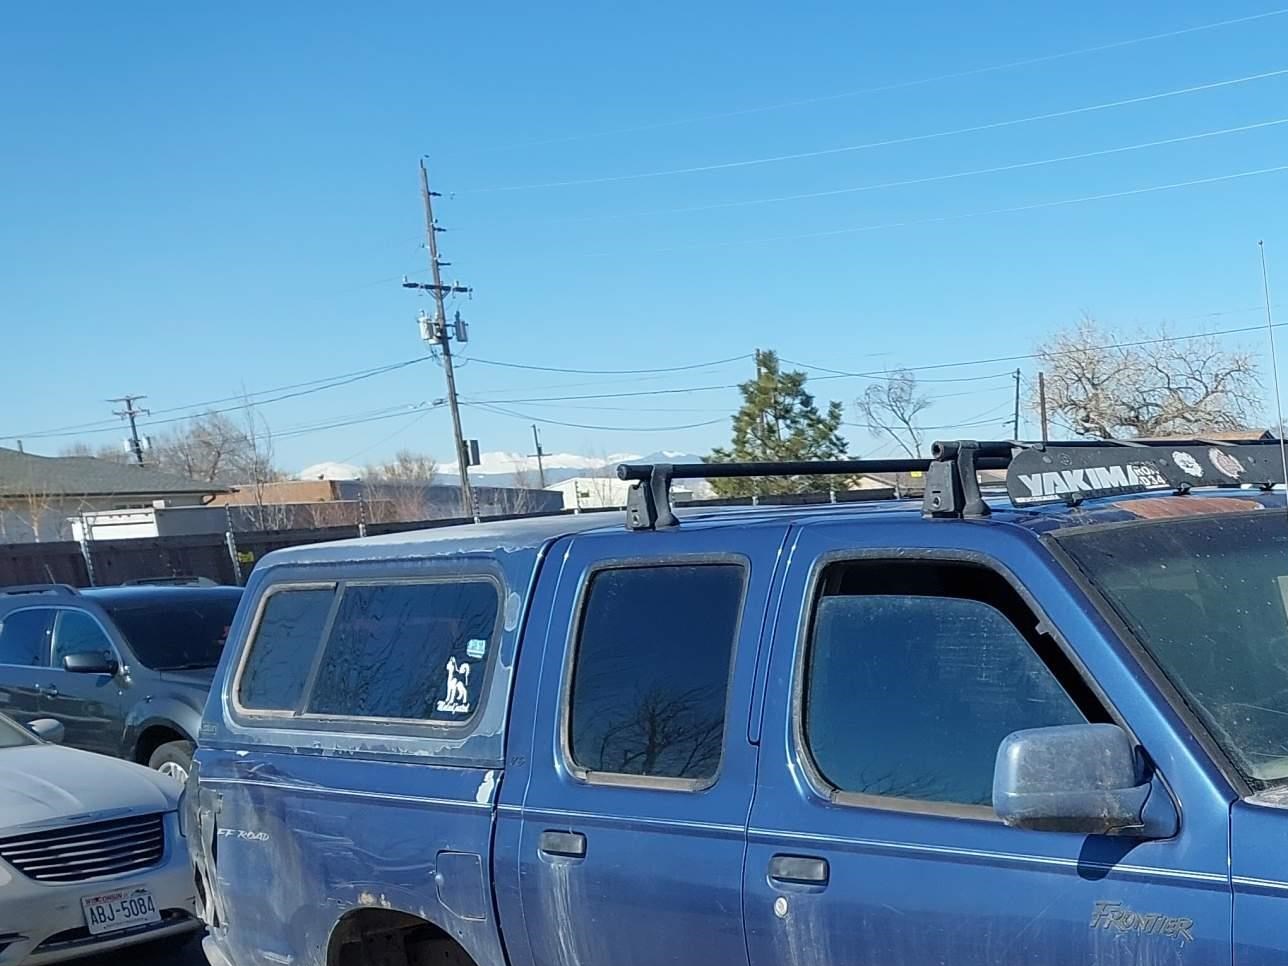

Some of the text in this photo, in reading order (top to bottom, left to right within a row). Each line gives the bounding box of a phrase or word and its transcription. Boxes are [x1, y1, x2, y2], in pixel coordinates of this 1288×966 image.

[237, 830, 270, 841] ROAD
[90, 896, 155, 925] ABJ-5084
[1090, 900, 1194, 942] FRONTIER
